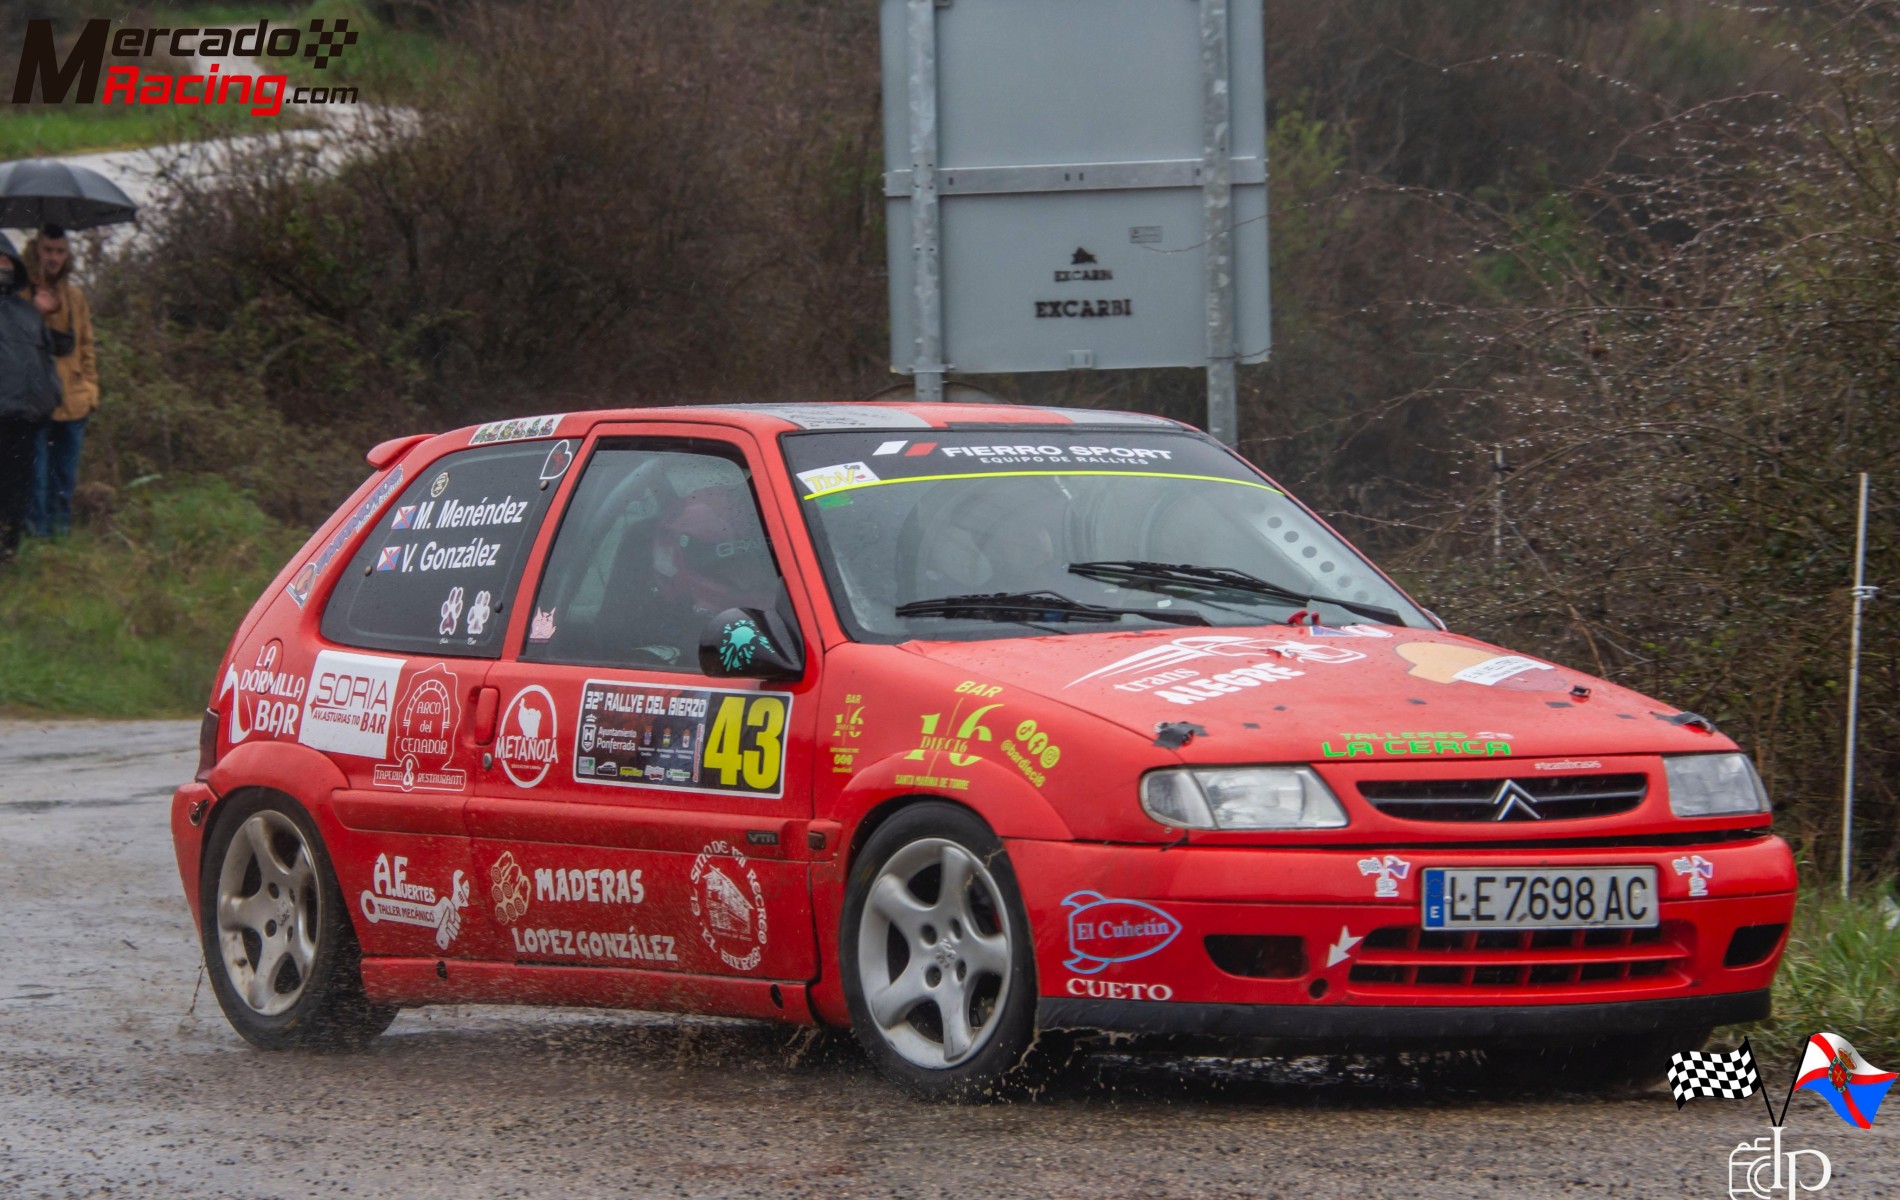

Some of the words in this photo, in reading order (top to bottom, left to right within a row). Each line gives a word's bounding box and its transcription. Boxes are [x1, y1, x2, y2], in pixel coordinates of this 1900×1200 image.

[1035, 299, 1132, 318] EXCARBI
[941, 445, 1063, 458] FIERRO
[1068, 446, 1174, 460] SPORT
[979, 456, 1044, 464] EQUIPO
[1075, 456, 1149, 465] RALLYES
[412, 501, 435, 530] M.
[436, 496, 528, 528] Menéndez
[401, 543, 418, 573] V.
[420, 538, 501, 571] González
[255, 645, 277, 670] LA
[240, 669, 306, 702] DORMILLA
[955, 681, 1004, 698] BAR
[1113, 668, 1200, 691] trans
[1154, 662, 1306, 705] ALEGRE
[315, 672, 388, 712] SORIA
[416, 701, 441, 715] ARCO
[604, 692, 645, 714] RALLYE
[645, 695, 666, 716] DEL
[667, 697, 707, 718] BIERZO
[254, 699, 299, 738] BAR
[360, 711, 387, 735] BAR
[419, 720, 433, 733] del
[401, 738, 448, 755] CENADOR
[596, 738, 636, 753] Ponferrada
[703, 696, 785, 790] 43
[904, 704, 1005, 767] 16
[1340, 731, 1468, 741] TALLERES
[495, 735, 559, 764] METANOIA
[1322, 741, 1374, 758] LA
[1383, 740, 1512, 757] CERCA
[534, 867, 645, 904] MADERAS
[377, 902, 401, 918] TALLER
[1450, 876, 1496, 921] LE
[1504, 876, 1596, 922] 7698
[1604, 876, 1649, 921] AC
[1430, 906, 1440, 919] E
[511, 927, 576, 955] LOPEZ
[576, 925, 678, 961] GONZÁLEZ
[1076, 922, 1095, 941] El
[1066, 977, 1173, 1001] CUETO
